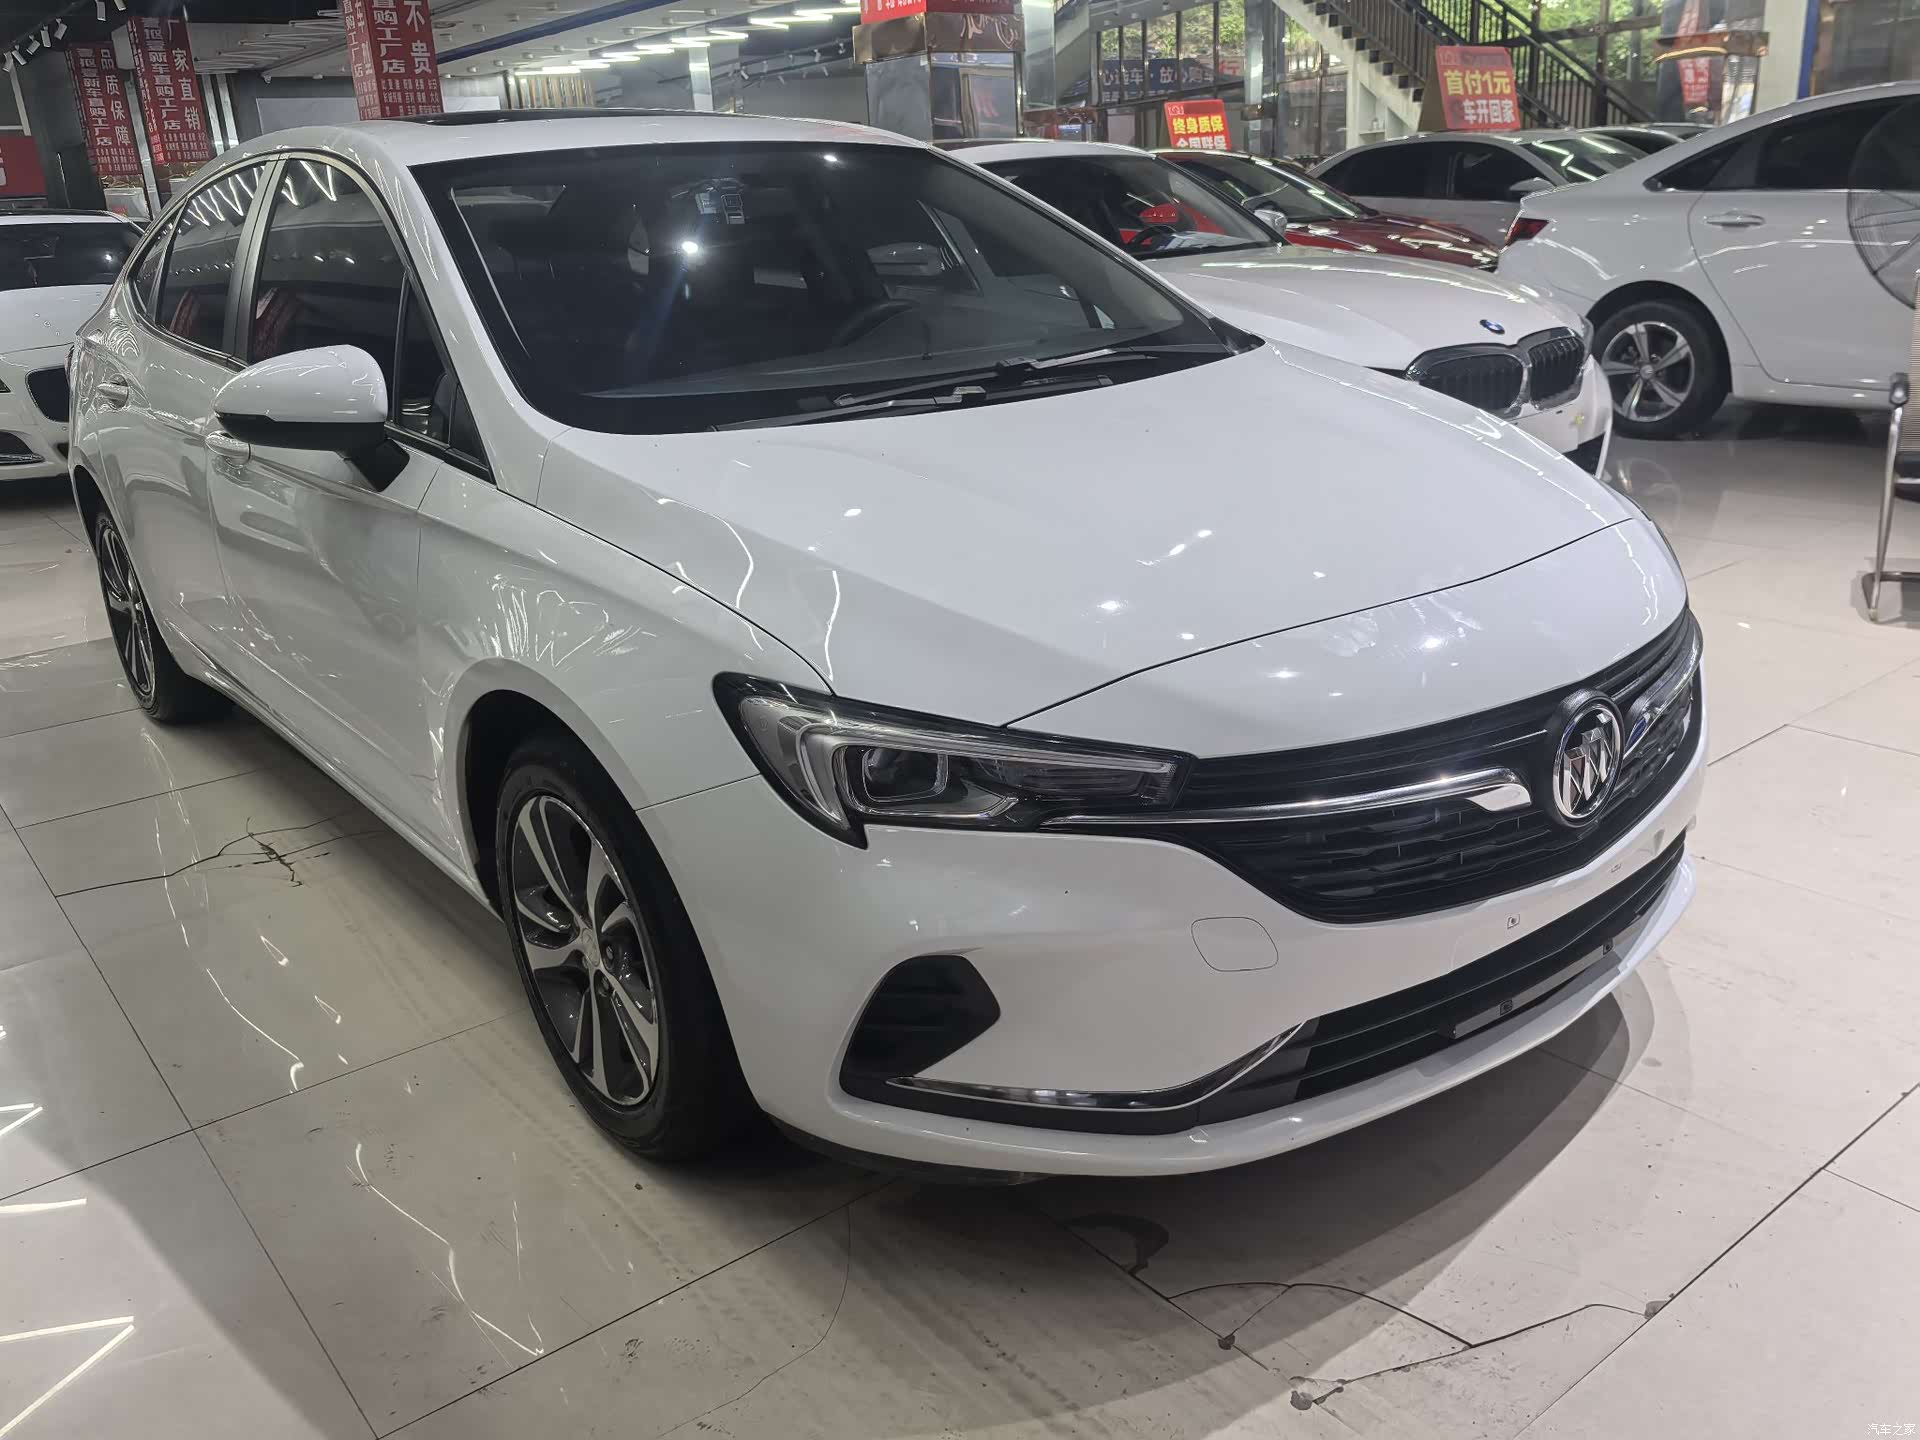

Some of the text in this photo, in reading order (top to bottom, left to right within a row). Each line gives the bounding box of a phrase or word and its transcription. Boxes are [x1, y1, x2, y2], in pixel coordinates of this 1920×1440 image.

[403, 0, 432, 75] 不贵
[101, 49, 131, 147] 品质保障
[167, 19, 201, 131] 厂家直销
[1444, 69, 1511, 96] 首付1元
[1173, 115, 1224, 134] 终身质保
[1463, 98, 1515, 124] 车开回家
